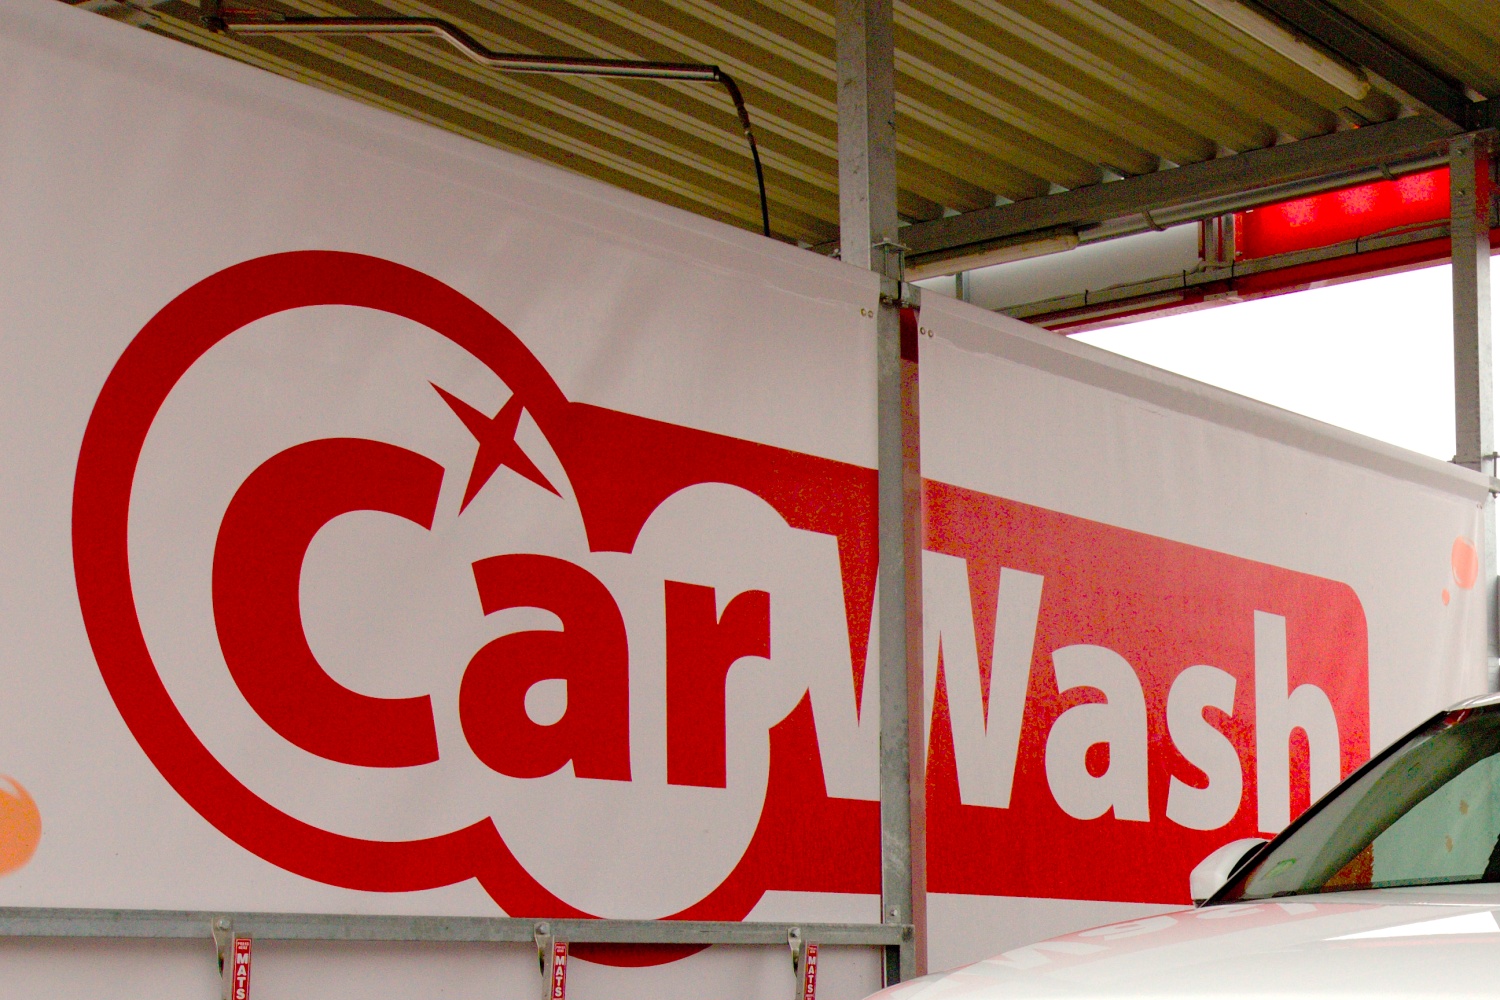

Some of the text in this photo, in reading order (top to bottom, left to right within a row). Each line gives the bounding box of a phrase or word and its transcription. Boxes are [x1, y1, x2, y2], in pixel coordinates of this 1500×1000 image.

[212, 437, 1341, 836] CarWash
[236, 953, 248, 999] MATS
[555, 955, 565, 997] MATS
[807, 956, 816, 993] MATS
